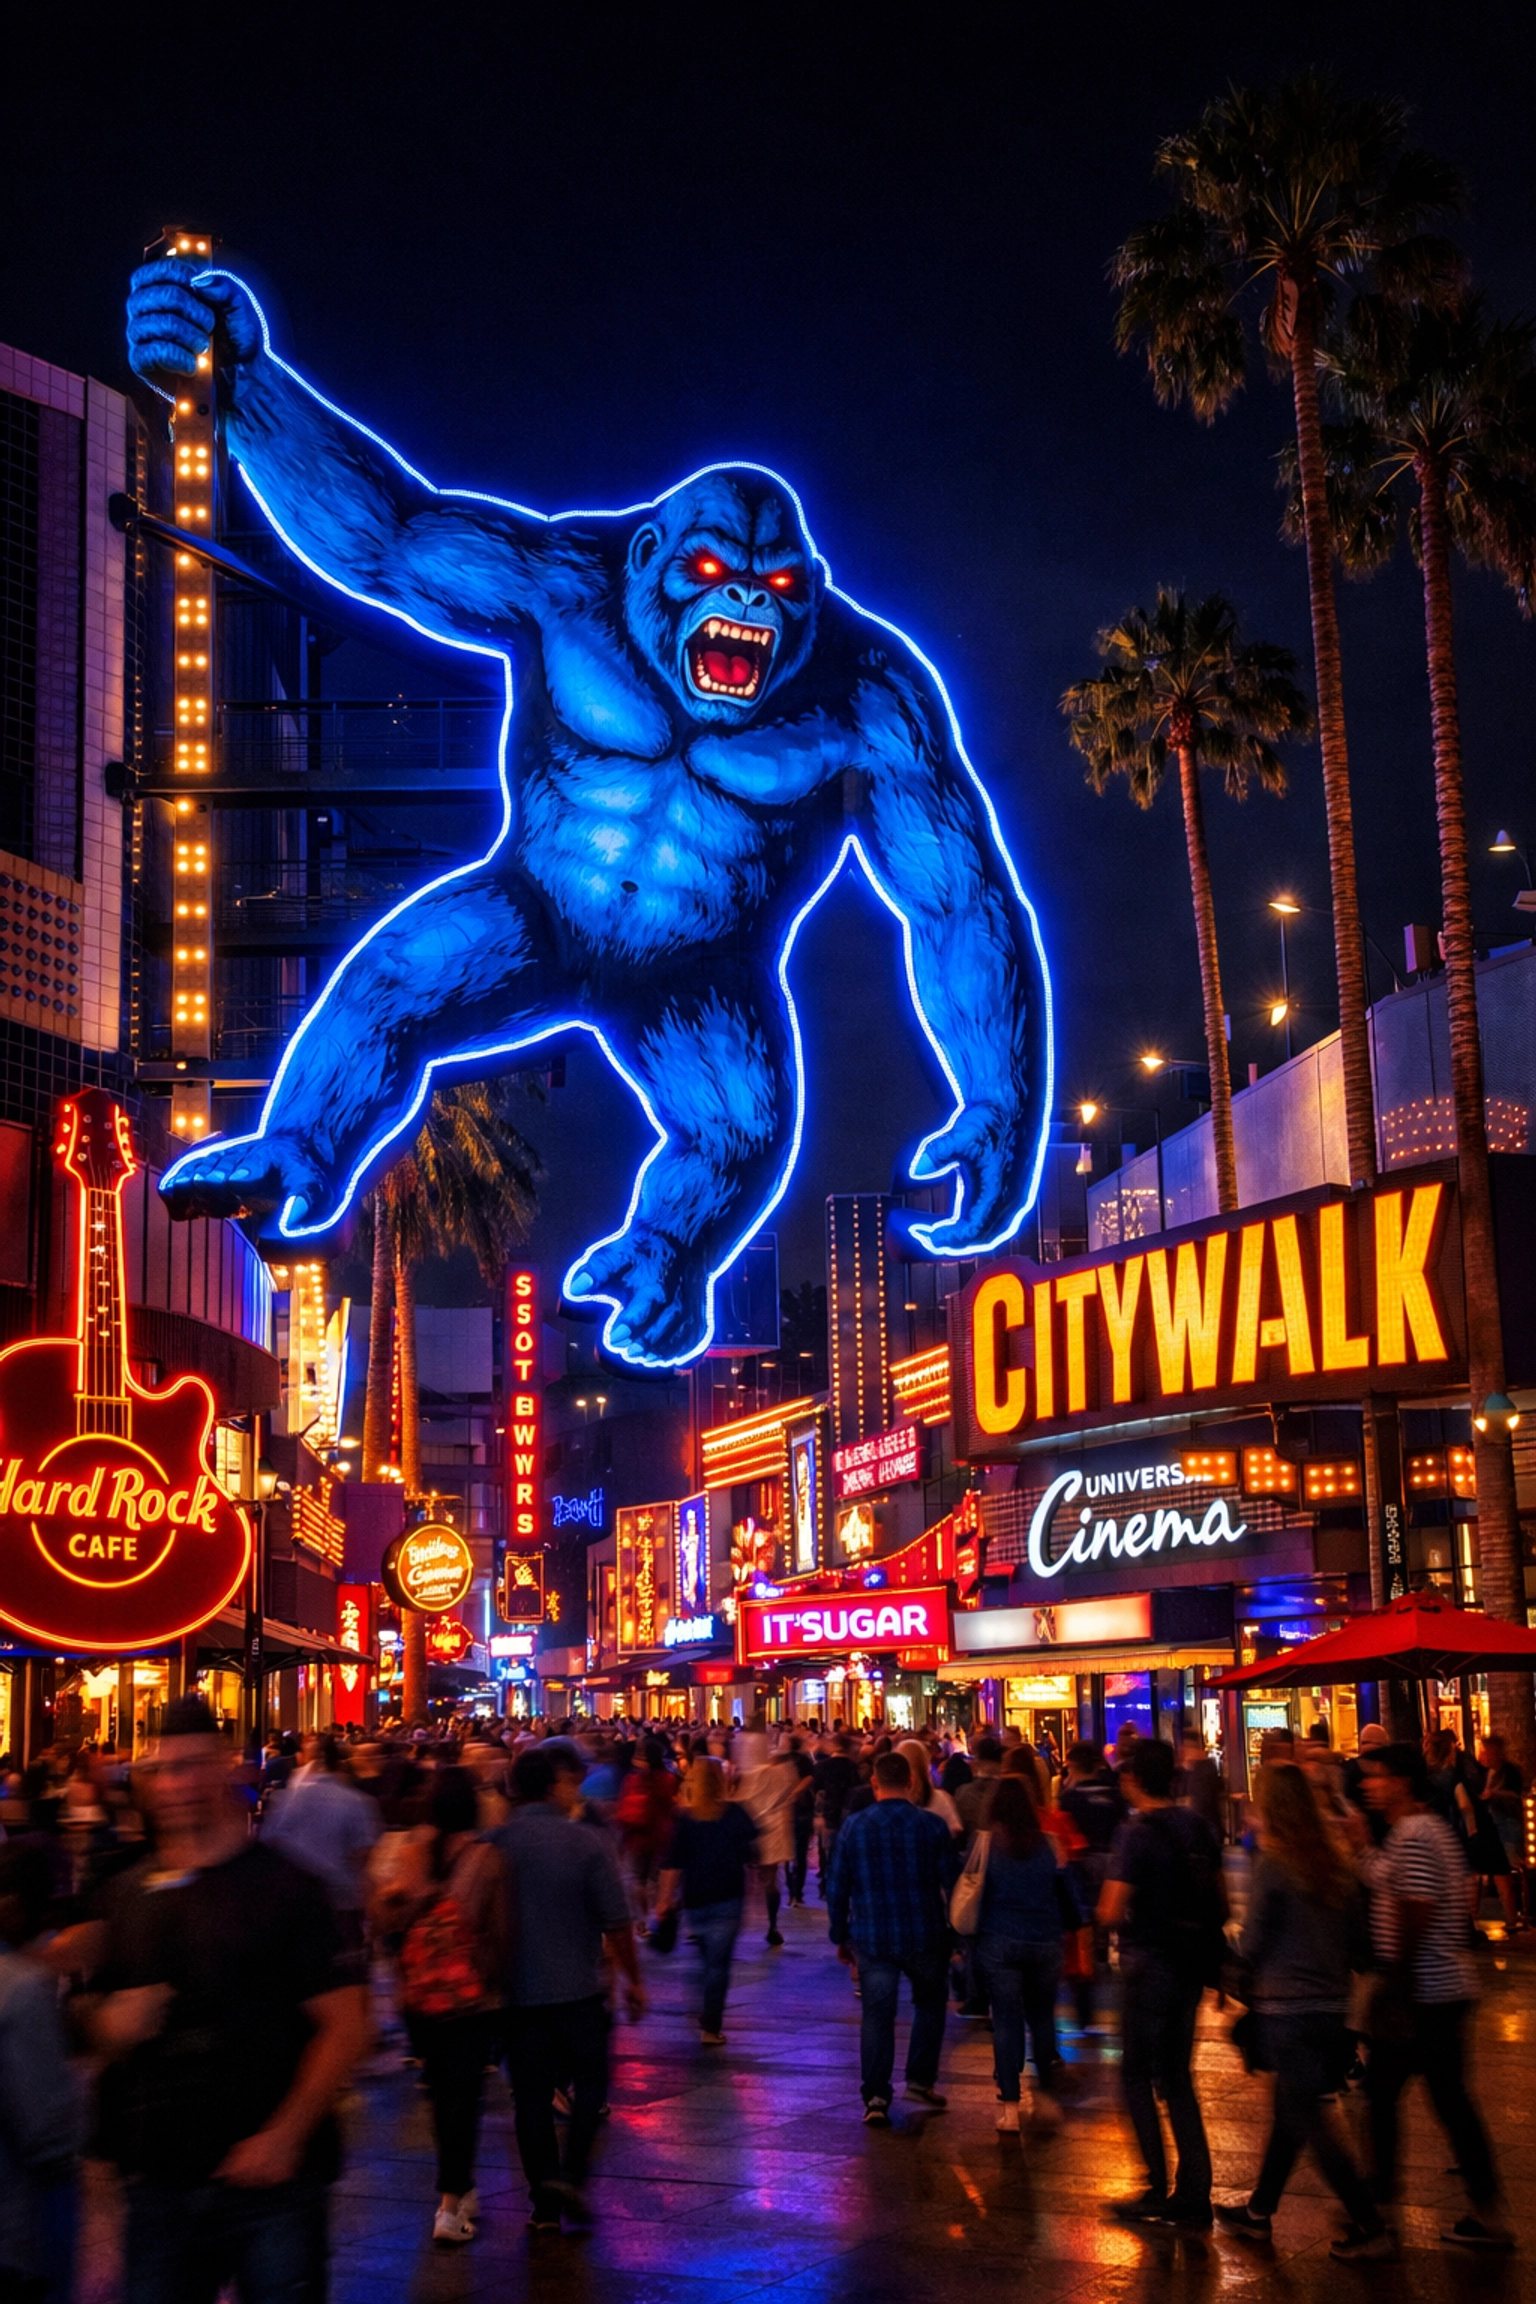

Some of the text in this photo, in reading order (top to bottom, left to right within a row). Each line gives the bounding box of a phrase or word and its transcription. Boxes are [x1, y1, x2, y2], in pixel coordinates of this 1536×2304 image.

[972, 1183, 1447, 1434] CITYWALK
[0, 1458, 218, 1533] Hard Rock
[1085, 1462, 1214, 1498] UNIVERS
[68, 1533, 138, 1561] CAFE
[1028, 1469, 1247, 1578] Cinema
[763, 1605, 929, 1643] IT'SUGAR
